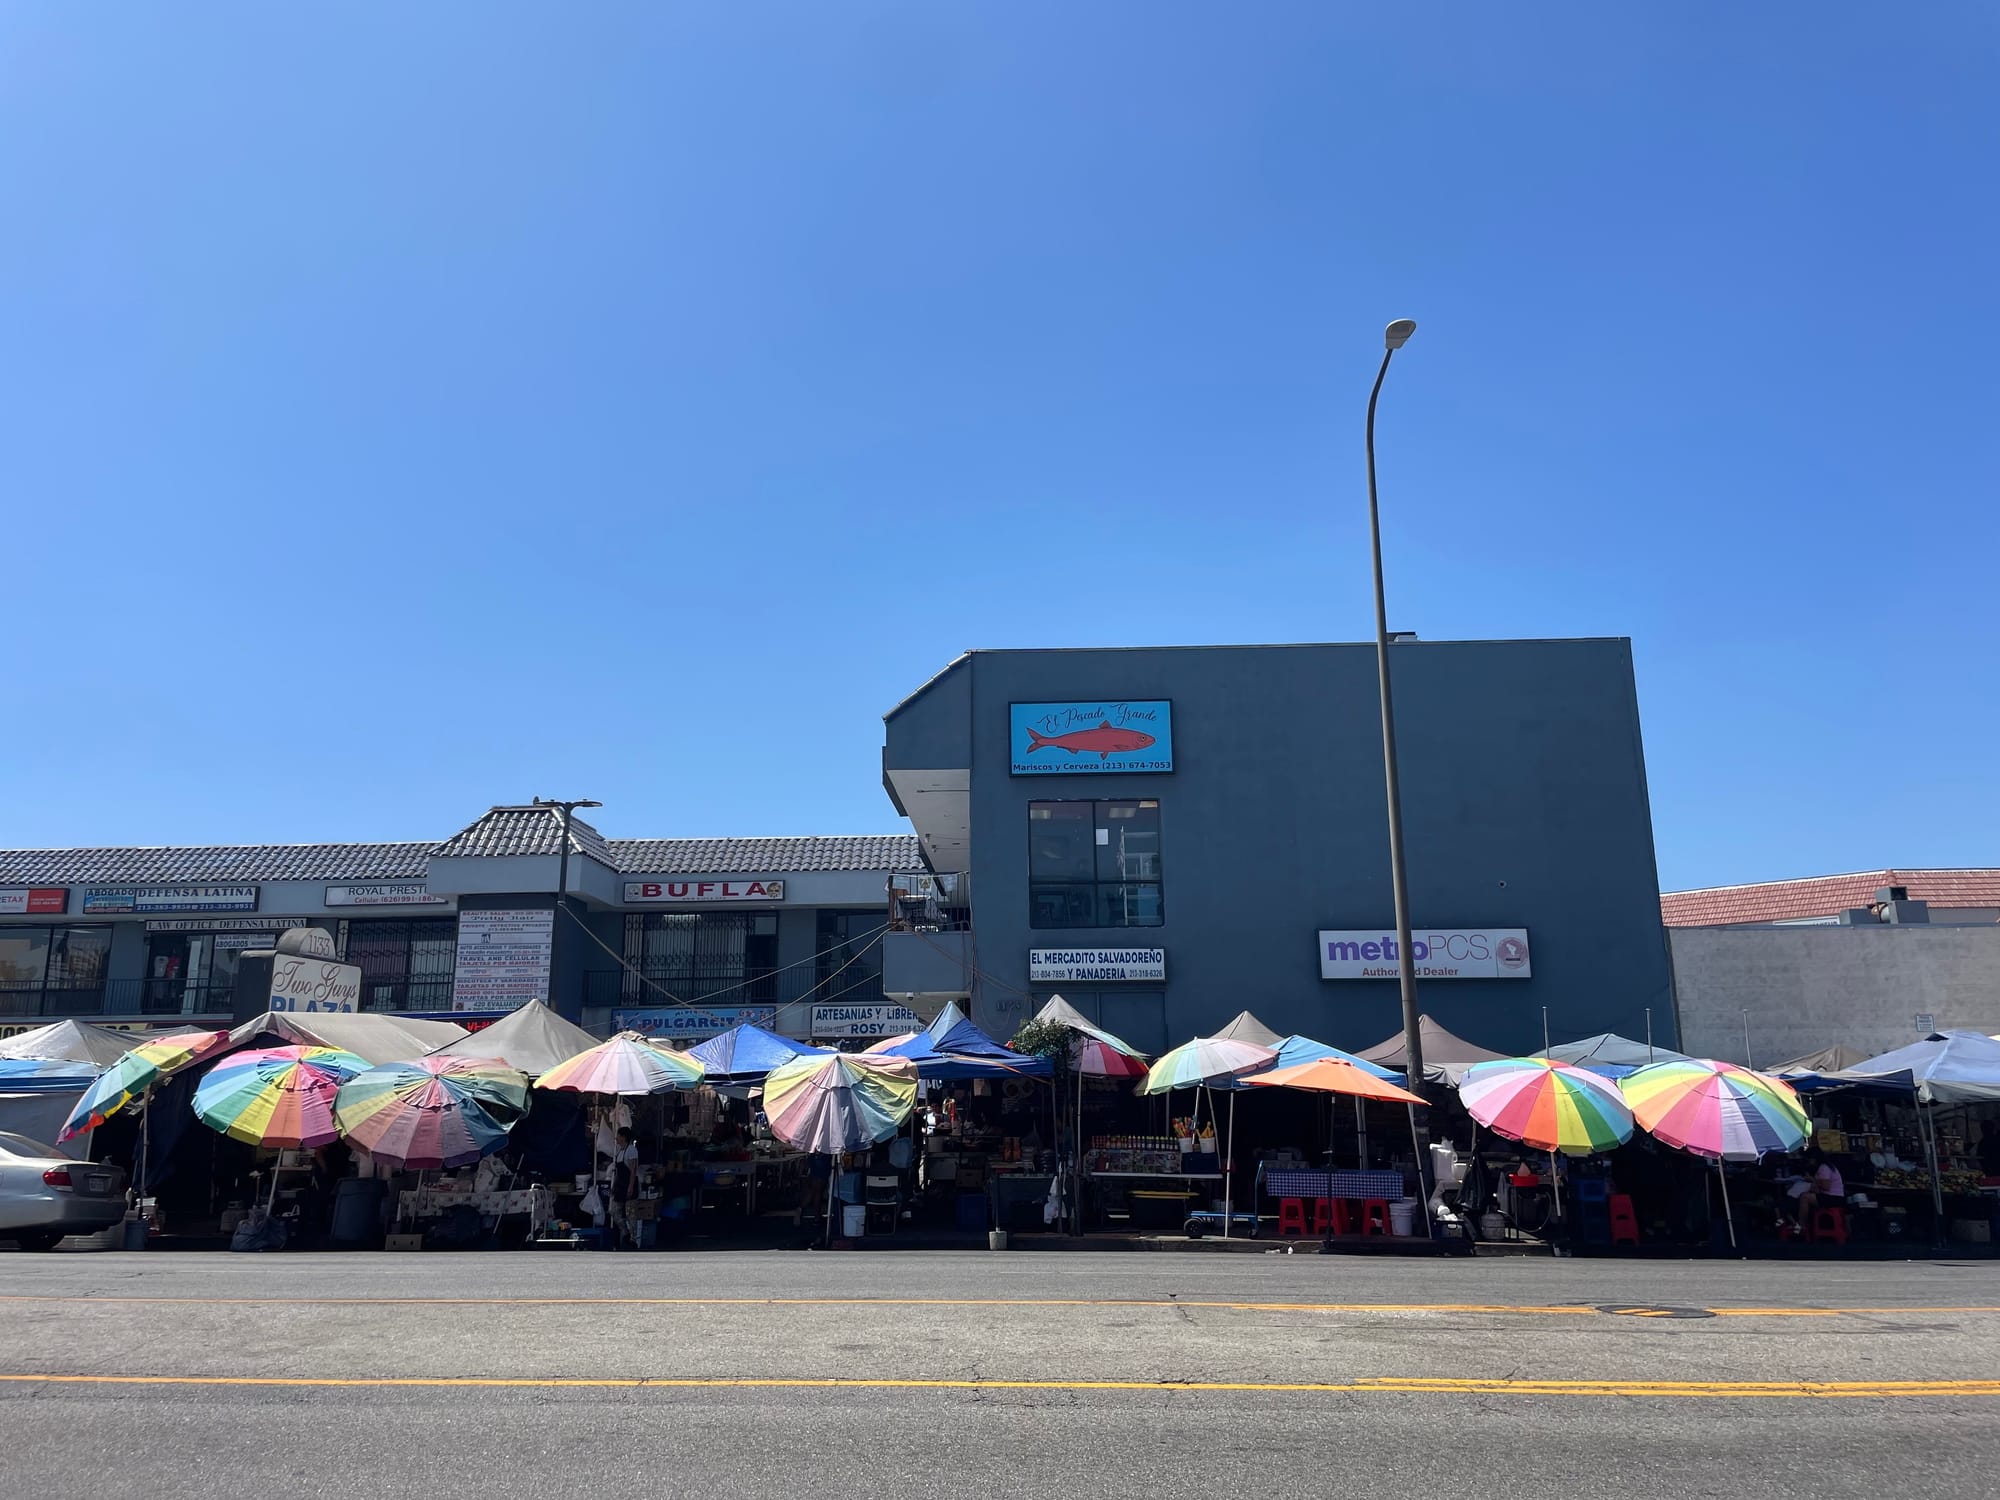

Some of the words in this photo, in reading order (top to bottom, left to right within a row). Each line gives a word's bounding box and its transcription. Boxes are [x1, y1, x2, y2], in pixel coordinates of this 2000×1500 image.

[1037, 713, 1058, 733] El
[1112, 703, 1157, 726] Grande
[1013, 763, 1053, 771] Mariscos
[1055, 764, 1060, 772] y
[1063, 762, 1099, 770] Cerveza
[1102, 762, 1126, 770] (213)
[1128, 761, 1171, 769] 674-7053
[87, 889, 135, 897] ABOGADO
[139, 888, 199, 897] DEFENSA
[204, 888, 254, 897] LATINA
[348, 887, 385, 895] ROYAL
[641, 882, 767, 897] BUFLA
[149, 921, 170, 929] LAW
[176, 921, 215, 929] OFFICE
[220, 920, 264, 929] DEFENSA
[267, 919, 306, 928] LATINA
[216, 940, 249, 948] ABOGADOS
[309, 935, 331, 956] 1133
[1031, 952, 1042, 964] EL
[1044, 952, 1095, 964] MERCADITO
[1098, 949, 1162, 963] SALVADOREÑO
[1067, 968, 1074, 979] Y
[1076, 968, 1126, 979] PANADERIA
[1362, 967, 1421, 977] Authord
[1424, 967, 1458, 977] Dealer
[273, 960, 313, 995] Two
[313, 963, 357, 1009] Guys
[815, 1008, 873, 1020] ARTESANIAS
[876, 1007, 882, 1020] Y
[850, 1023, 885, 1034] ROSY
